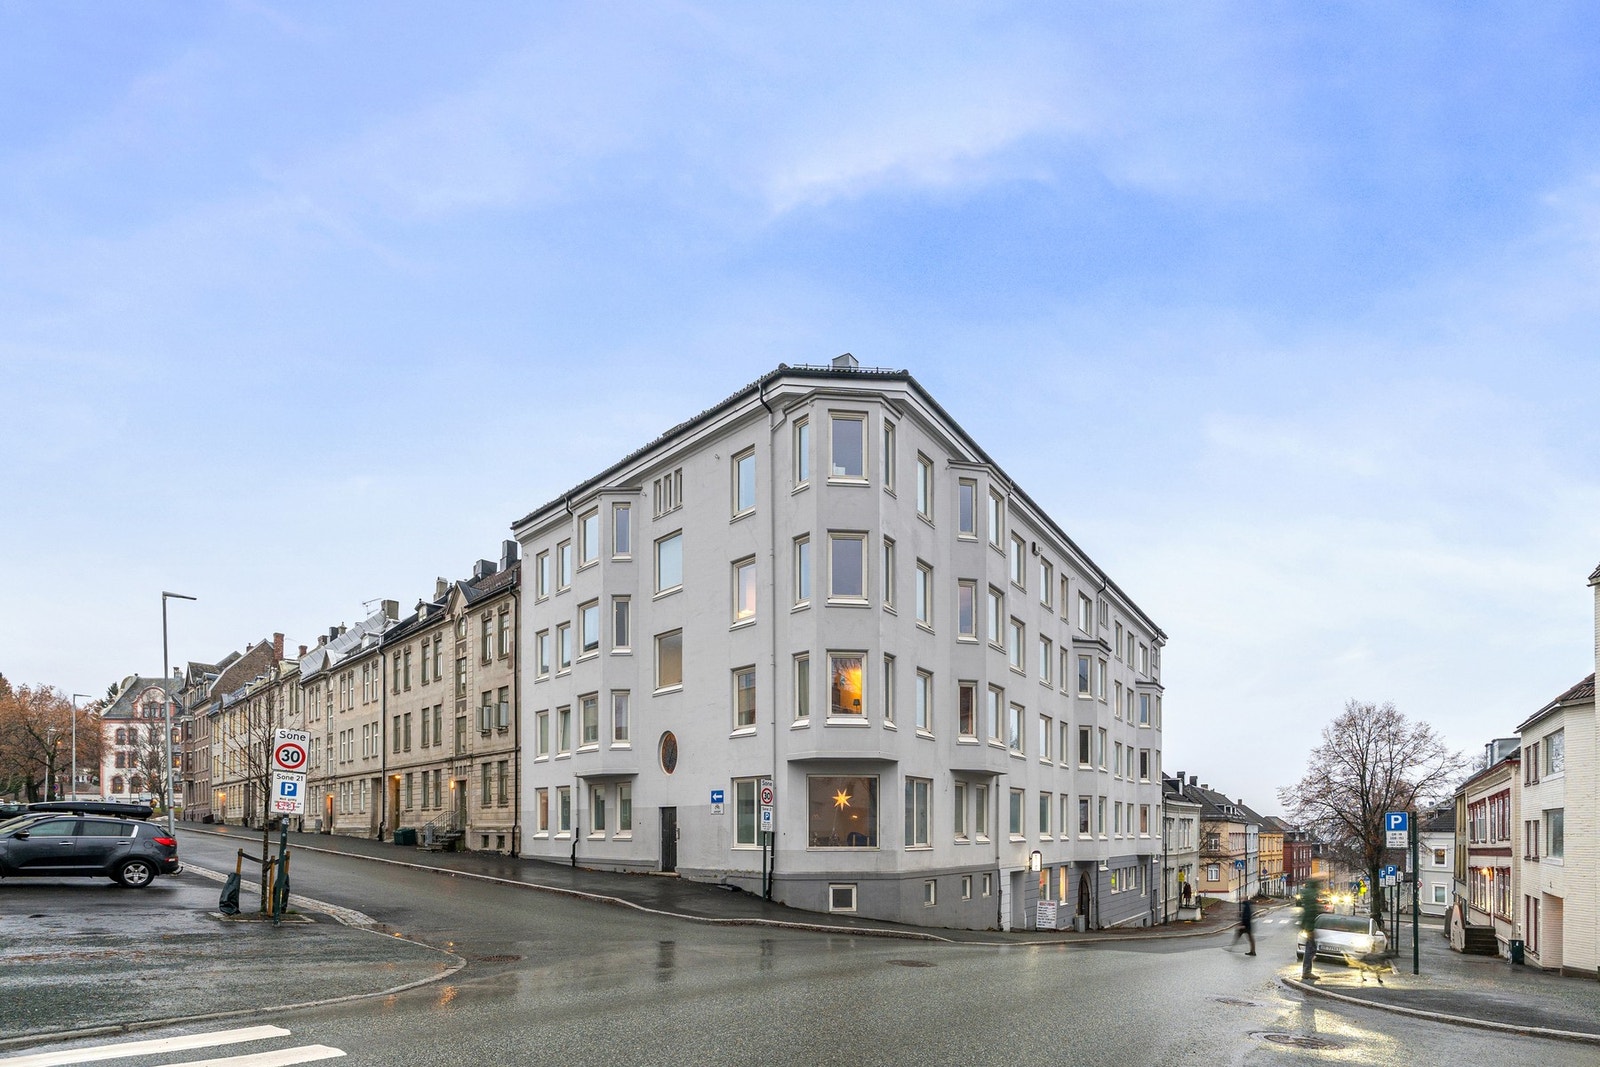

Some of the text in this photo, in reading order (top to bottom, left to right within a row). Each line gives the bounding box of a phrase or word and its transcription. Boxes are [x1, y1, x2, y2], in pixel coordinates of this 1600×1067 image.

[279, 730, 306, 741] Sone
[281, 749, 300, 763] 30
[276, 773, 294, 781] Sone
[284, 783, 294, 795] P
[1391, 815, 1402, 829] P
[1381, 870, 1386, 878] P
[1388, 866, 1394, 875] P
